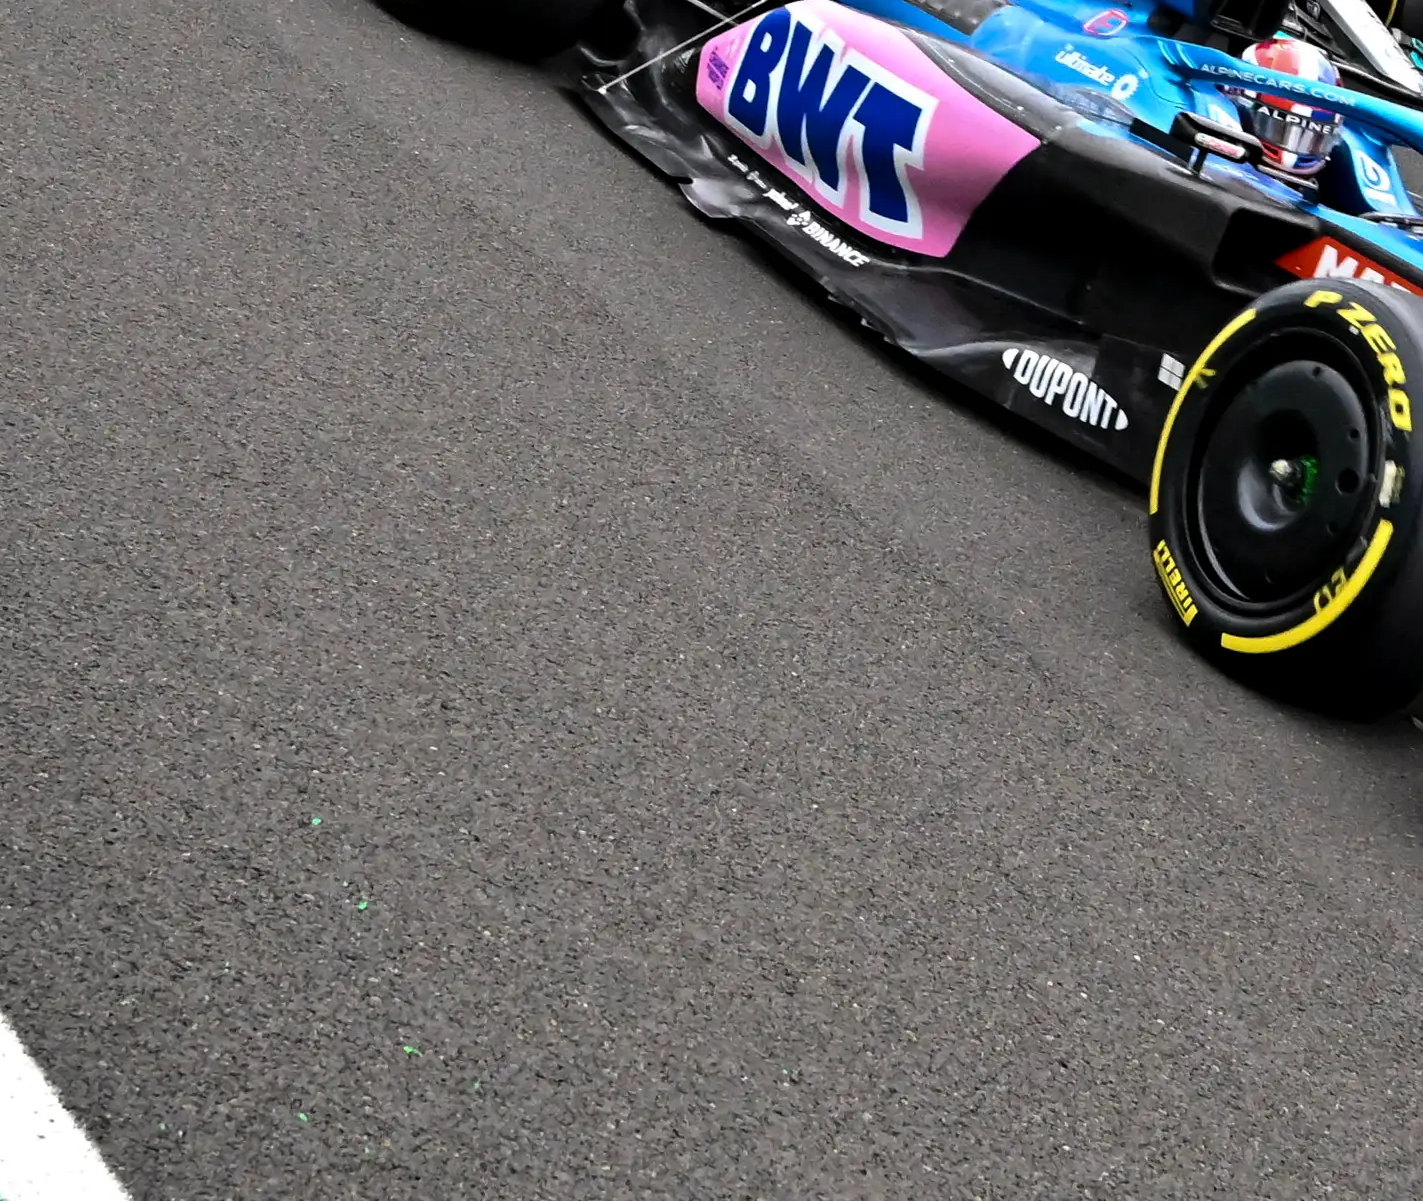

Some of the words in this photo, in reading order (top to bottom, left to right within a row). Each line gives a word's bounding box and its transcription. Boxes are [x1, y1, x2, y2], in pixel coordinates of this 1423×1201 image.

[727, 5, 924, 226] BWT
[1200, 62, 1357, 107] ALPINECARS.COM
[1257, 106, 1332, 135] ALPINE
[802, 220, 871, 268] BINANCE
[1013, 348, 1119, 431] DUPONT
[1303, 289, 1343, 309] P
[1336, 302, 1413, 433] ZERO
